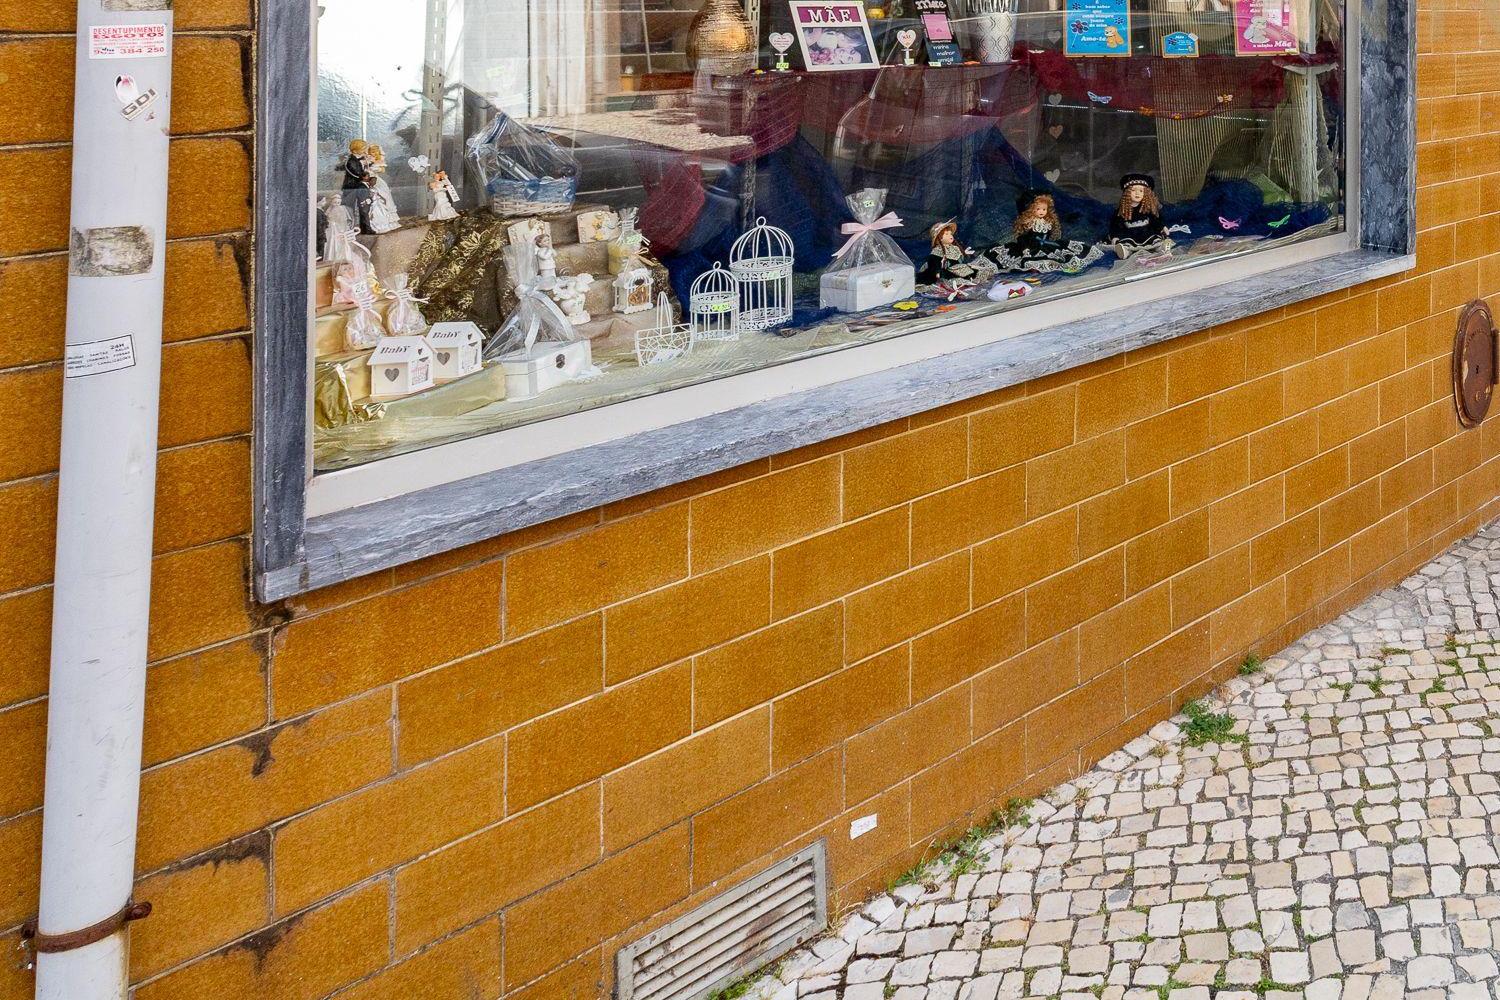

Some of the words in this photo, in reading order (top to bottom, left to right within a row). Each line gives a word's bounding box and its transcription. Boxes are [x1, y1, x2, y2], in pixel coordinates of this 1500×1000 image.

[808, 5, 851, 23] MÃE
[93, 26, 164, 35] DESENTUPIMENTOS
[122, 88, 156, 116] GDI
